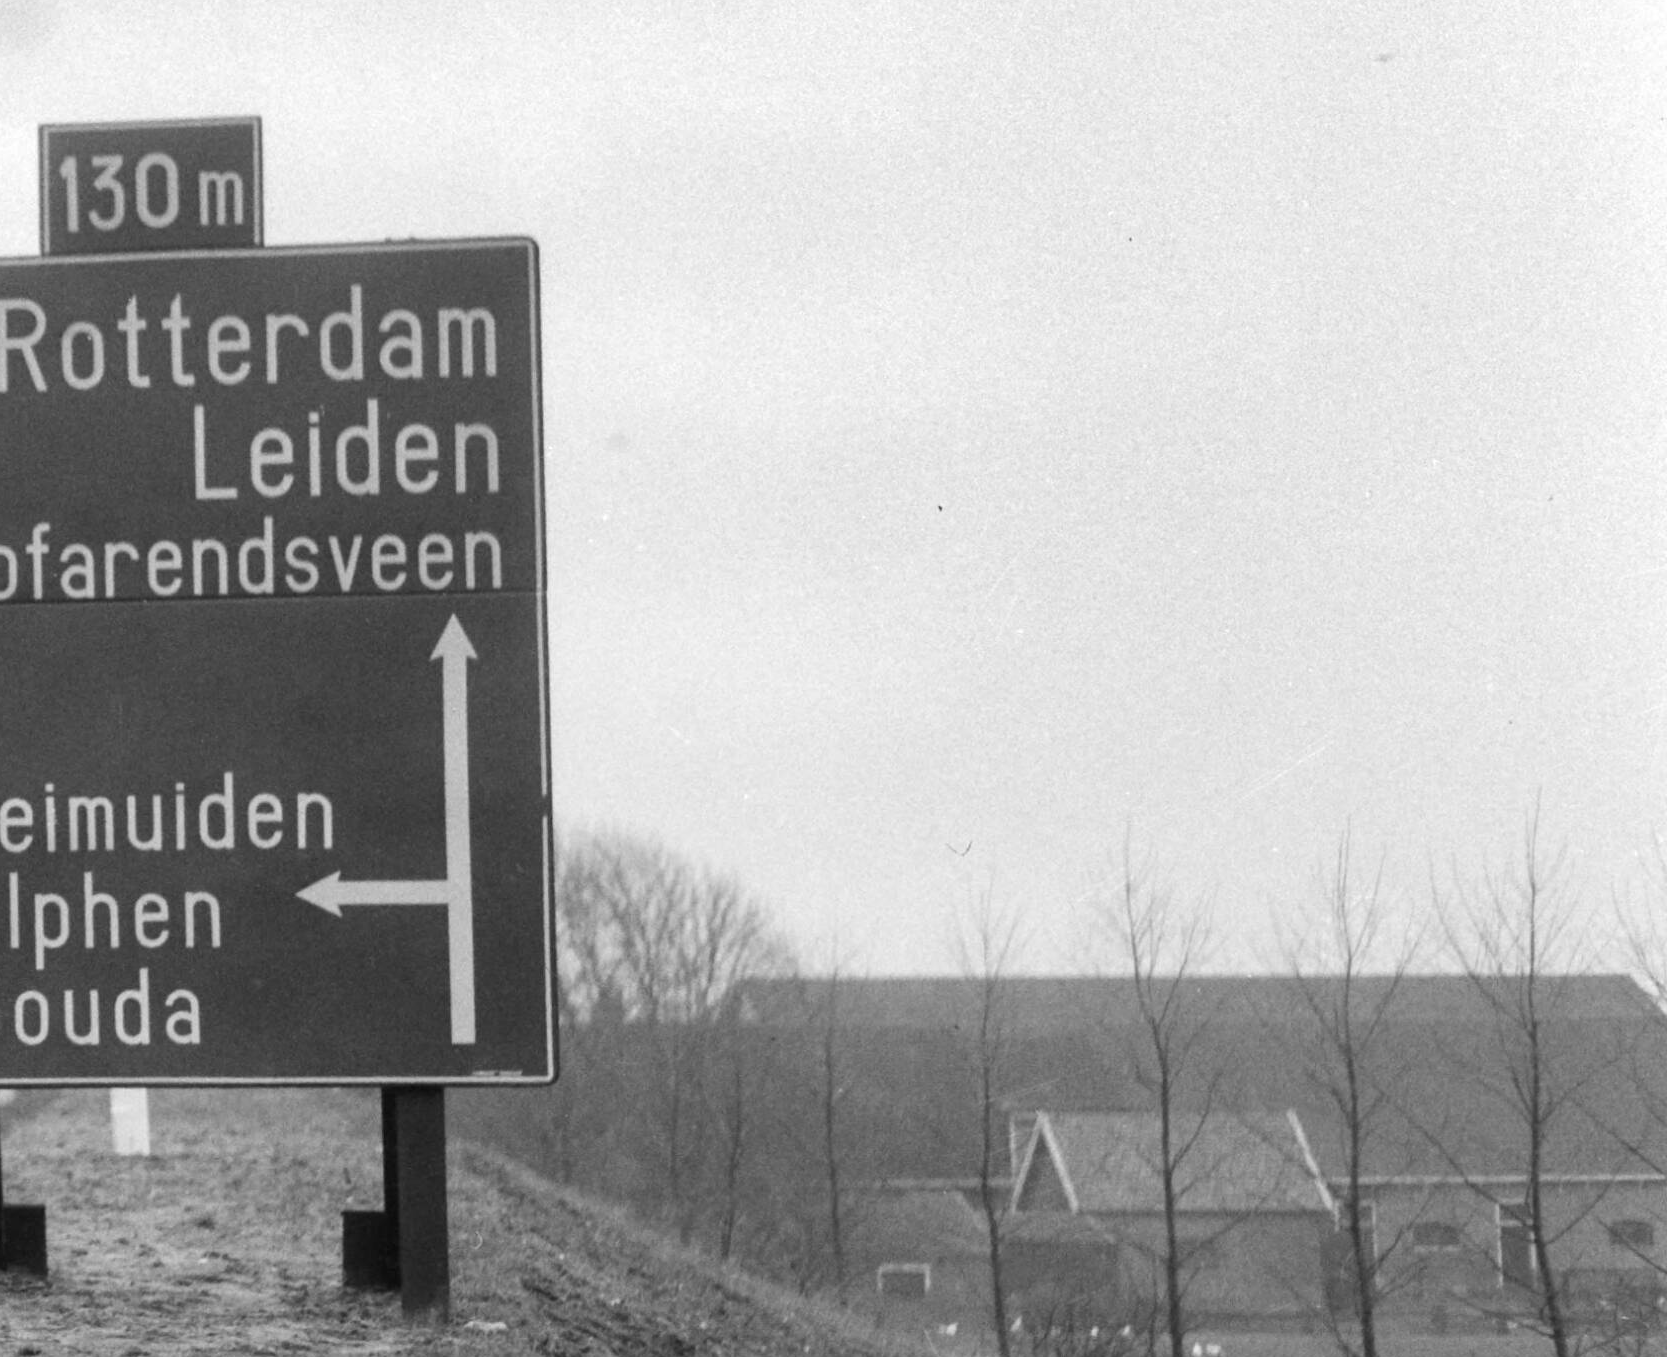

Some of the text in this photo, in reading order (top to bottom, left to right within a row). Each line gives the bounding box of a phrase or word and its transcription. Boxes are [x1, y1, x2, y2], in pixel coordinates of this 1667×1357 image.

[58, 151, 244, 233] 130 m
[193, 398, 500, 500] Leiden
